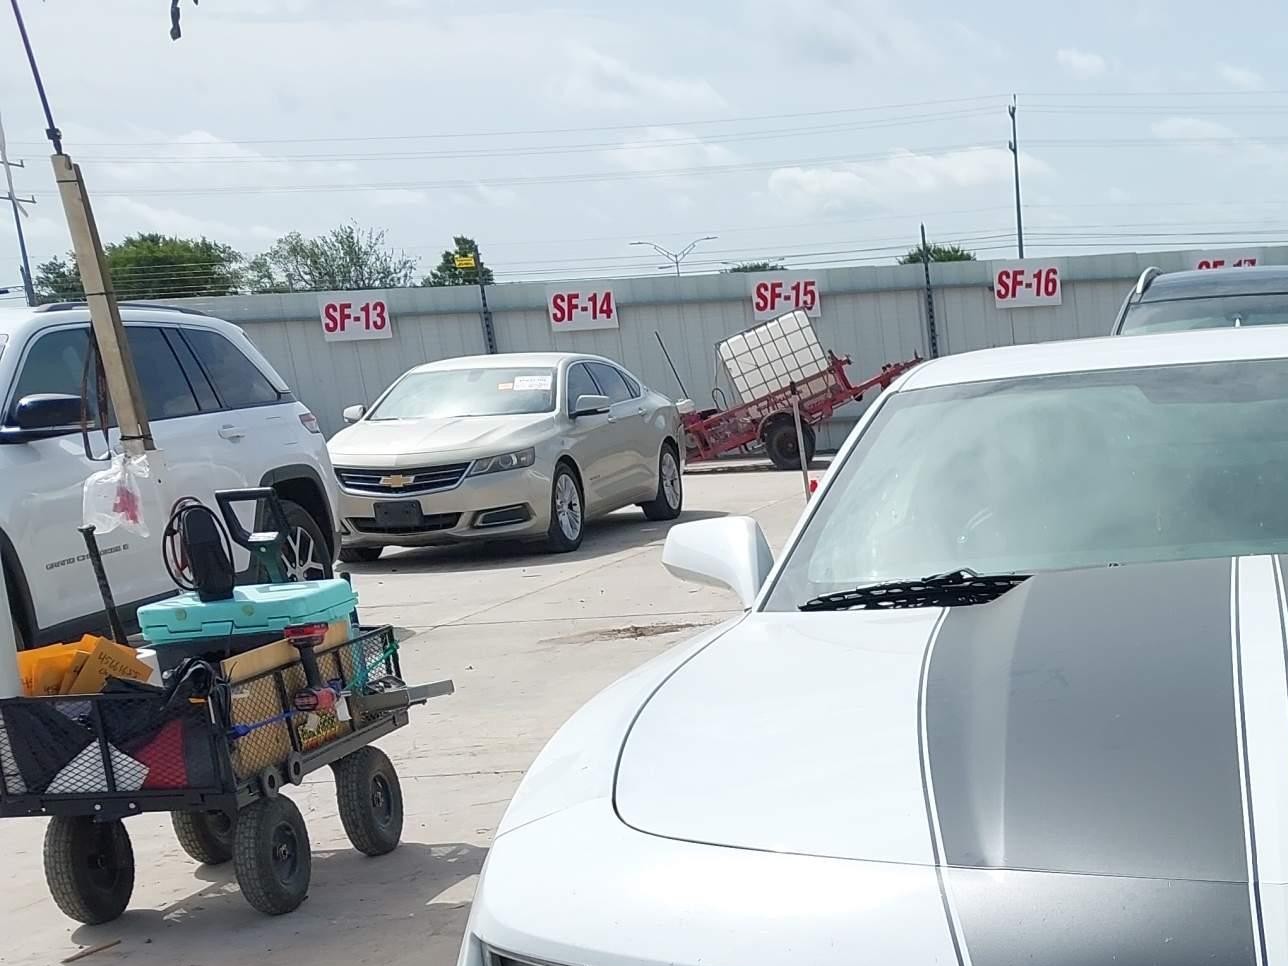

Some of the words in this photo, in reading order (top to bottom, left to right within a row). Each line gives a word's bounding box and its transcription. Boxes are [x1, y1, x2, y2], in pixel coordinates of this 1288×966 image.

[755, 281, 816, 312] SF-15
[996, 268, 1058, 299] SF-16
[324, 301, 386, 333] SF-13
[552, 292, 613, 322] SF-14
[46, 556, 75, 570] GRAND
